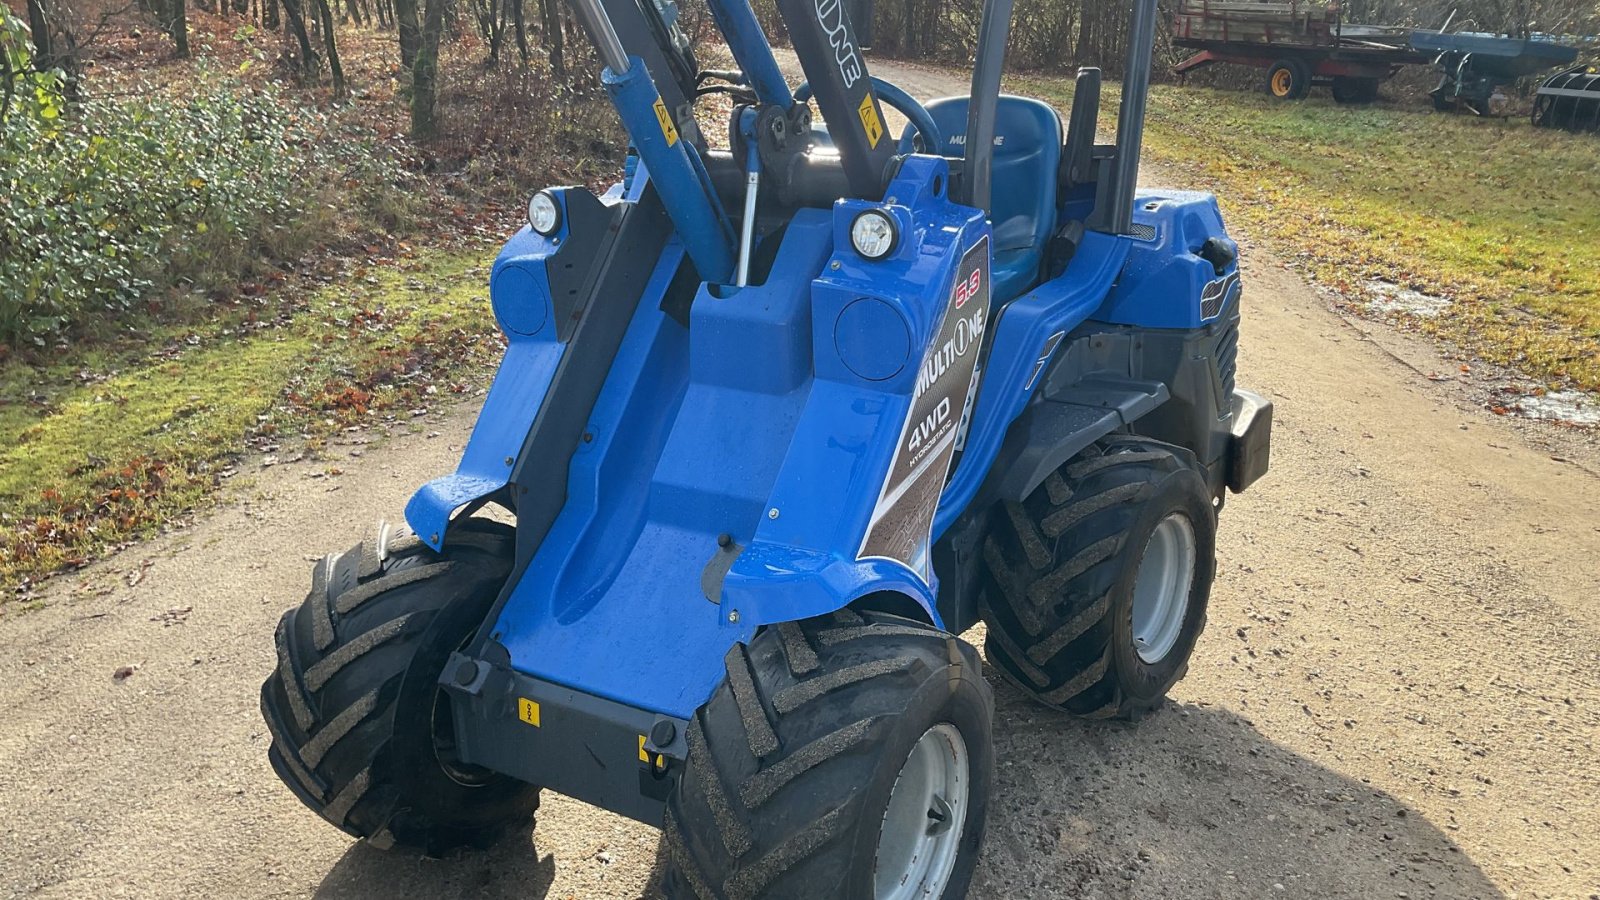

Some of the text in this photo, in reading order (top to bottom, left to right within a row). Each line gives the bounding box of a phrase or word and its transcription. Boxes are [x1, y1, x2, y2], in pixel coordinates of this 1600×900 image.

[956, 268, 980, 309] 5.3
[909, 397, 950, 451] 4WD
[909, 419, 952, 468] HYDROSTATIC
